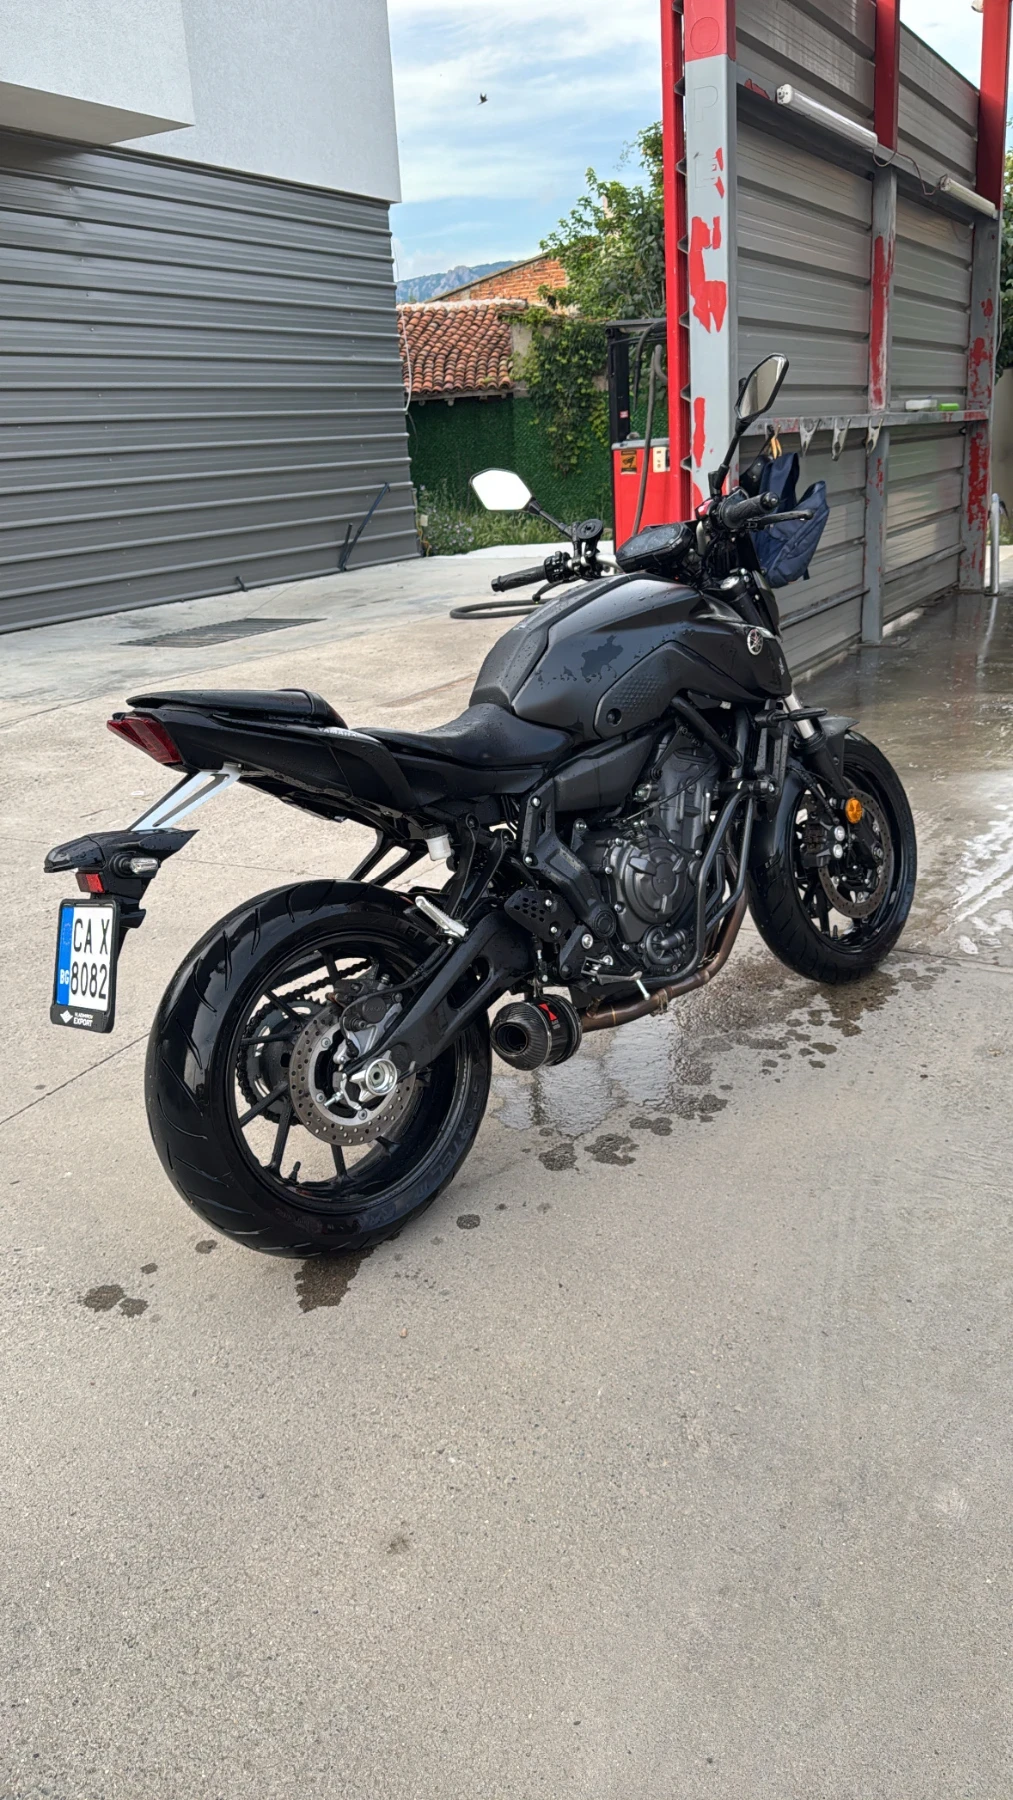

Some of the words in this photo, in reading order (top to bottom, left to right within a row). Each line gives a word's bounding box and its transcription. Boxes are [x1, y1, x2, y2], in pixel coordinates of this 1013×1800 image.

[317, 726, 357, 738] YAMAHA
[73, 917, 92, 954] CA
[99, 918, 110, 955] X
[59, 968, 70, 985] BG
[71, 961, 108, 1000] 8082
[73, 1017, 93, 1027] EXPORT
